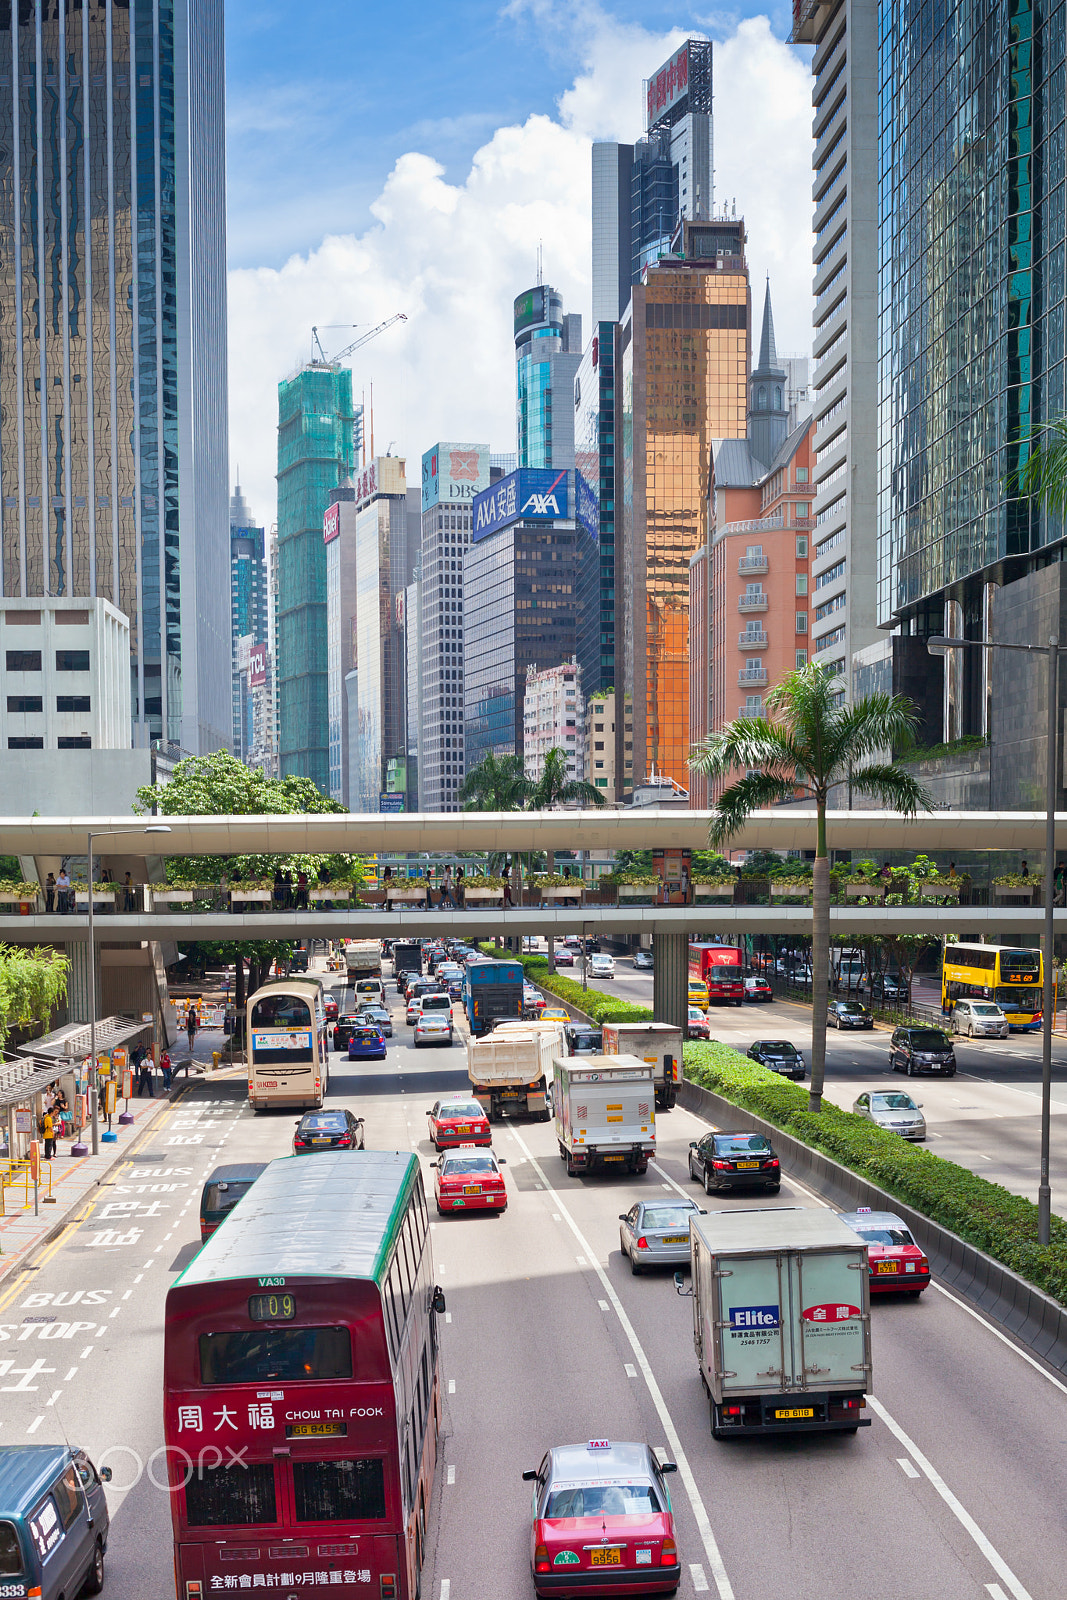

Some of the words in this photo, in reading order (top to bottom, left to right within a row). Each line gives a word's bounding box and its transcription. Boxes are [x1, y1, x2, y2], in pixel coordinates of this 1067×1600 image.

[450, 484, 480, 498] DBS
[476, 495, 496, 531] AXA
[498, 479, 516, 521] 安盛
[520, 494, 560, 514] AXA
[323, 512, 338, 537] Haier
[250, 653, 265, 675] TCL
[174, 1109, 233, 1117] STOP
[169, 1119, 222, 1130] 巴士
[163, 1134, 206, 1146] 站
[128, 1167, 194, 1179] BUS
[112, 1183, 189, 1194] STOP
[93, 1200, 172, 1220] 巴士
[85, 1226, 145, 1247] 站
[258, 1277, 286, 1287] VA30
[20, 1290, 113, 1308] BUS
[259, 1295, 292, 1317] 109
[0, 1358, 57, 1392] 士
[177, 1402, 275, 1433] 周大福
[285, 1411, 321, 1420] CHOW
[324, 1409, 344, 1418] TAI
[349, 1407, 383, 1417] FOOK
[293, 1425, 308, 1434] GG
[310, 1424, 340, 1433] 8455
[589, 1440, 609, 1448] TAXI
[592, 1555, 619, 1565] 9956
[210, 1569, 371, 1589] 全新會員計劃9月隆重登場
[0, 1584, 25, 1598] 333
